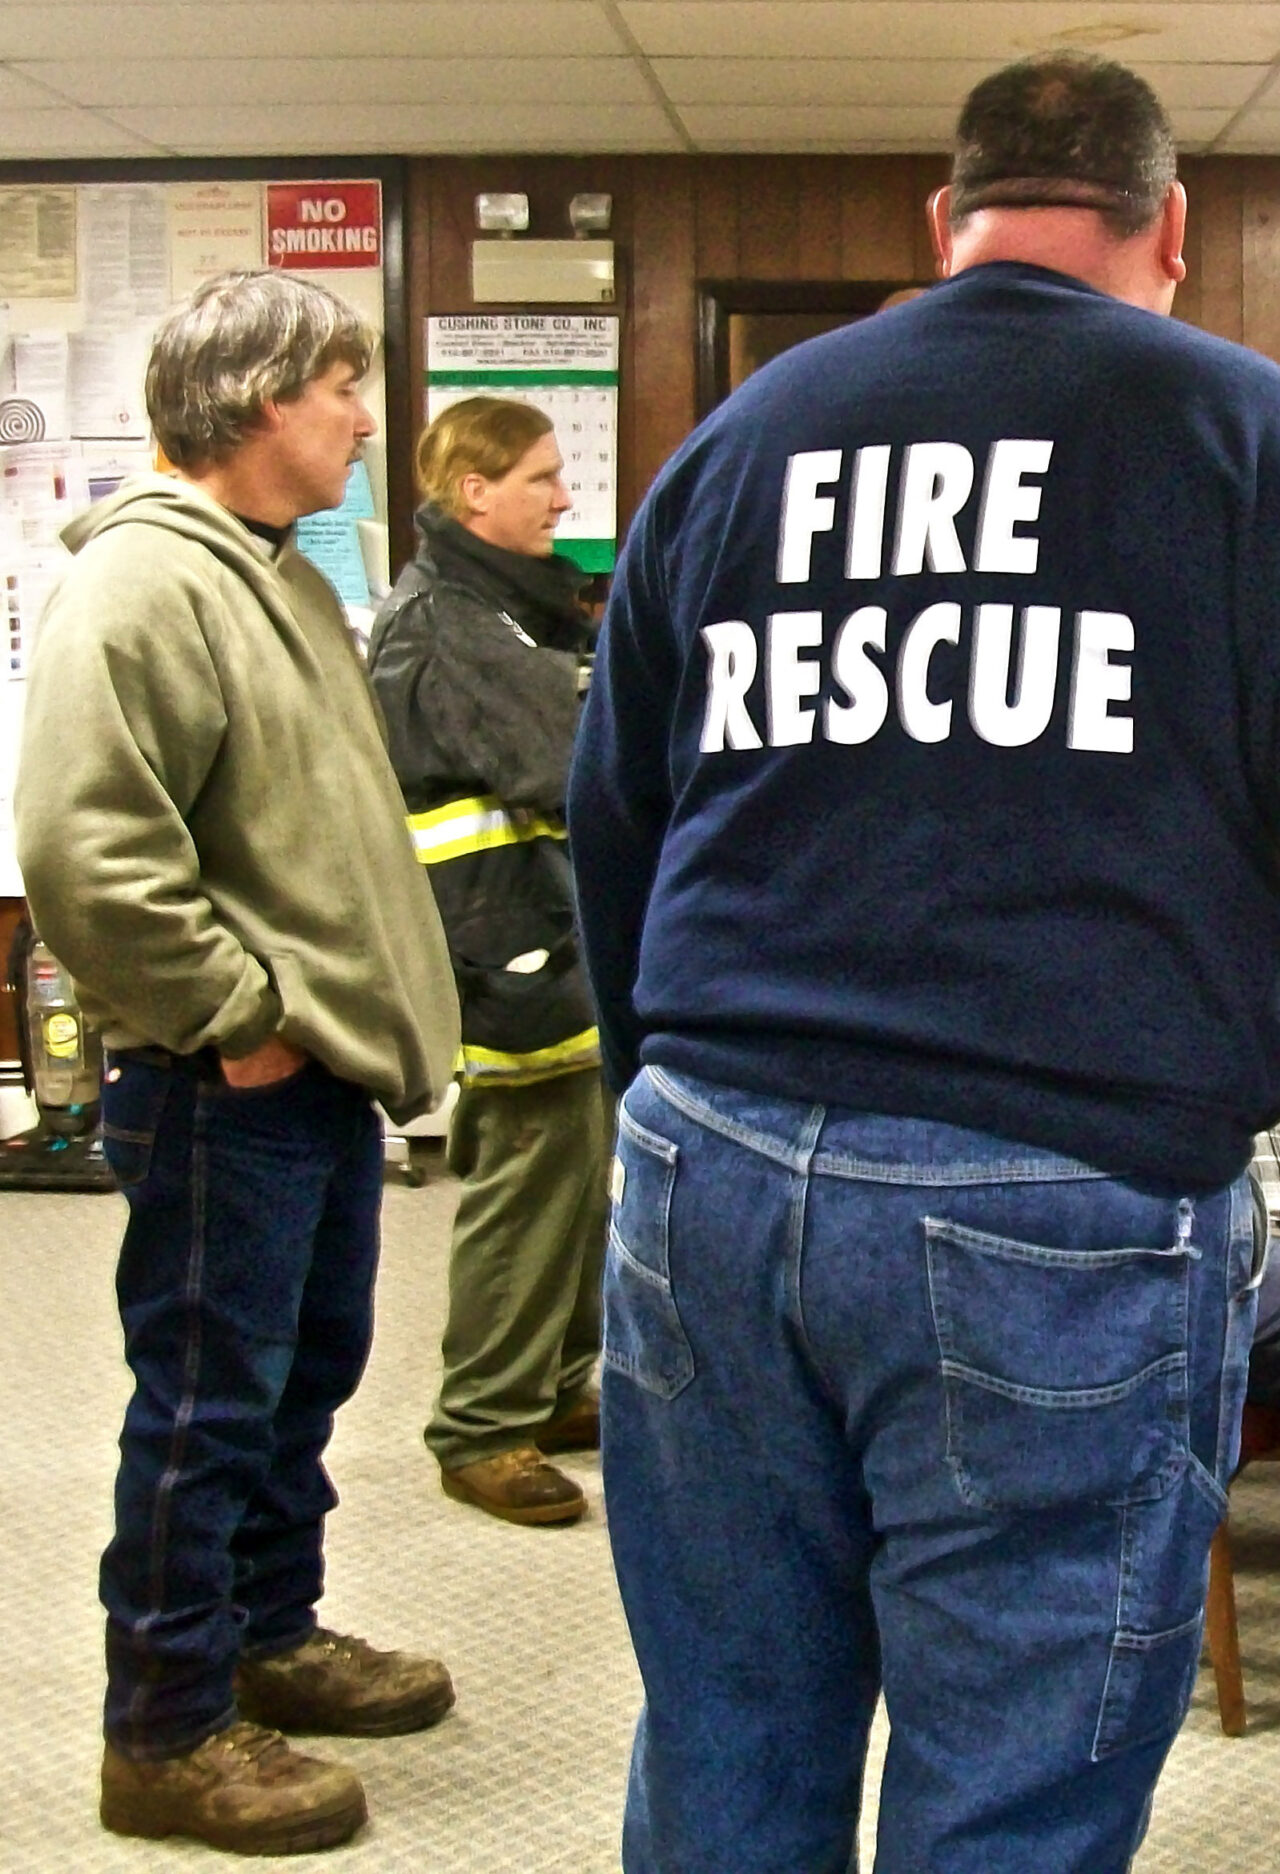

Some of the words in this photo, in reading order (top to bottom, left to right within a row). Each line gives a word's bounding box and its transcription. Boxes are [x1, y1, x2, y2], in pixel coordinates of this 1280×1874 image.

[301, 198, 346, 223] NO
[272, 227, 377, 253] SMOKING
[438, 318, 499, 331] CUSHING
[503, 318, 546, 331] STONE
[776, 439, 1054, 584] FIRE
[699, 601, 1135, 753] RESCUE
